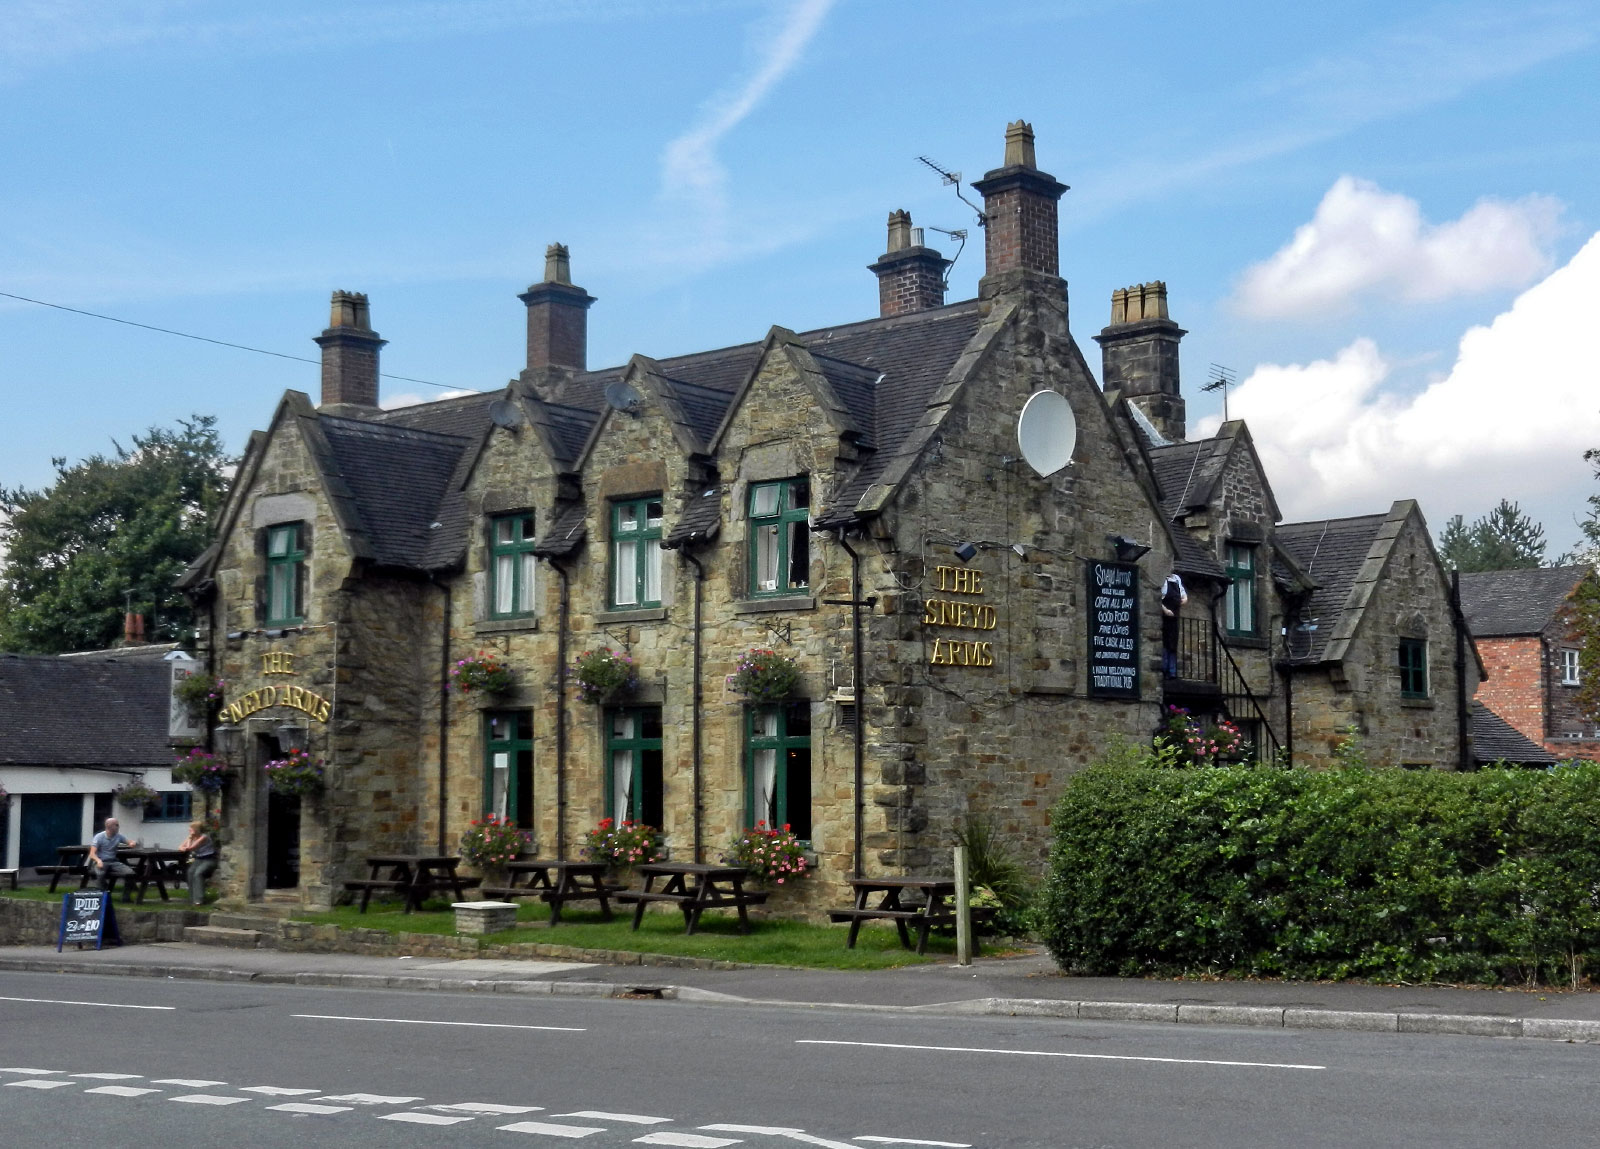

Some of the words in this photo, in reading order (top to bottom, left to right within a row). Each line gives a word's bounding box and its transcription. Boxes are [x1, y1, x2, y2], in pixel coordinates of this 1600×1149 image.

[936, 565, 984, 594] THE
[1094, 596, 1110, 609] OPEN
[1110, 598, 1121, 609] ALL
[1121, 598, 1134, 609] DAY
[923, 598, 997, 630] SNEYD
[1114, 610, 1130, 622] FOOD
[1098, 624, 1111, 634] FINE
[930, 637, 994, 667] ARMS
[261, 652, 297, 675] THE
[1108, 666, 1136, 677] WELCOMING
[1093, 675, 1123, 688] TRADITIONAL
[1123, 676, 1133, 689] PUB
[281, 684, 331, 724] ARMS
